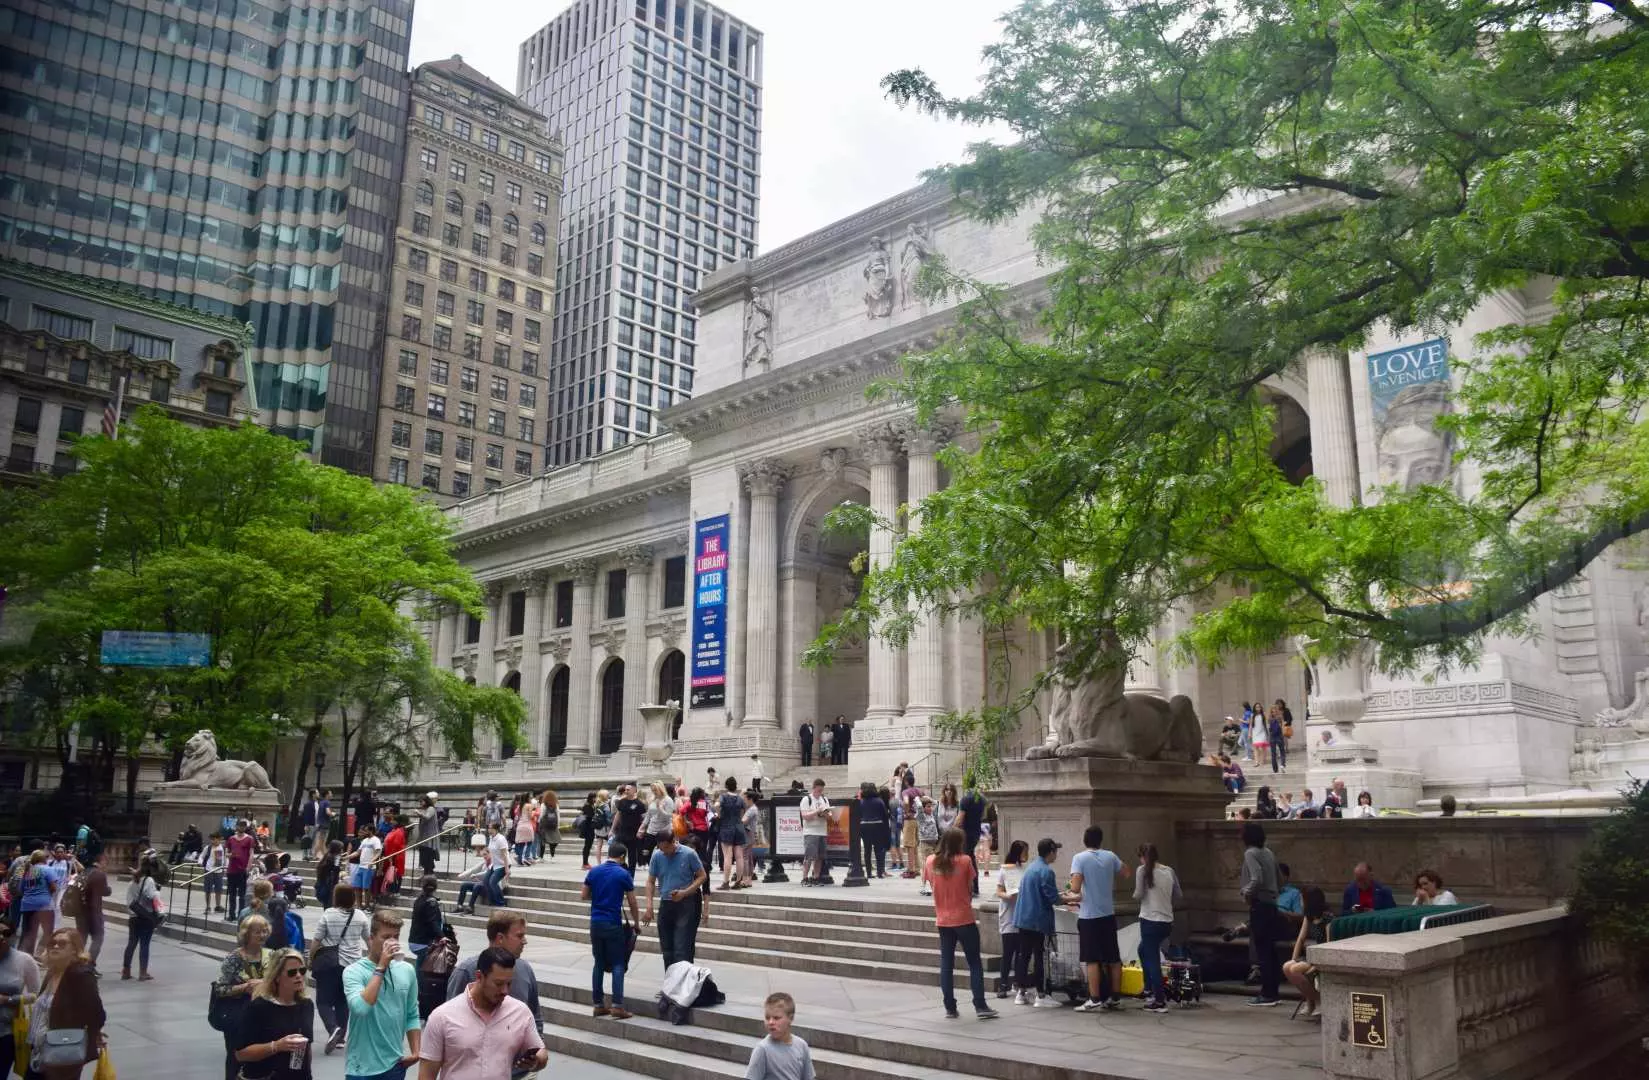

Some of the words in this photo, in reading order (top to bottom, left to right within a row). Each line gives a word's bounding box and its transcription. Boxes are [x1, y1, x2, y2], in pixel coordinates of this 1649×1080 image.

[1371, 344, 1444, 378] LOVE
[1388, 365, 1441, 385] VENICE
[705, 538, 718, 553] THE
[697, 553, 725, 571] LIBRARY
[700, 572, 721, 587] AFTER
[699, 588, 721, 604] HOURS
